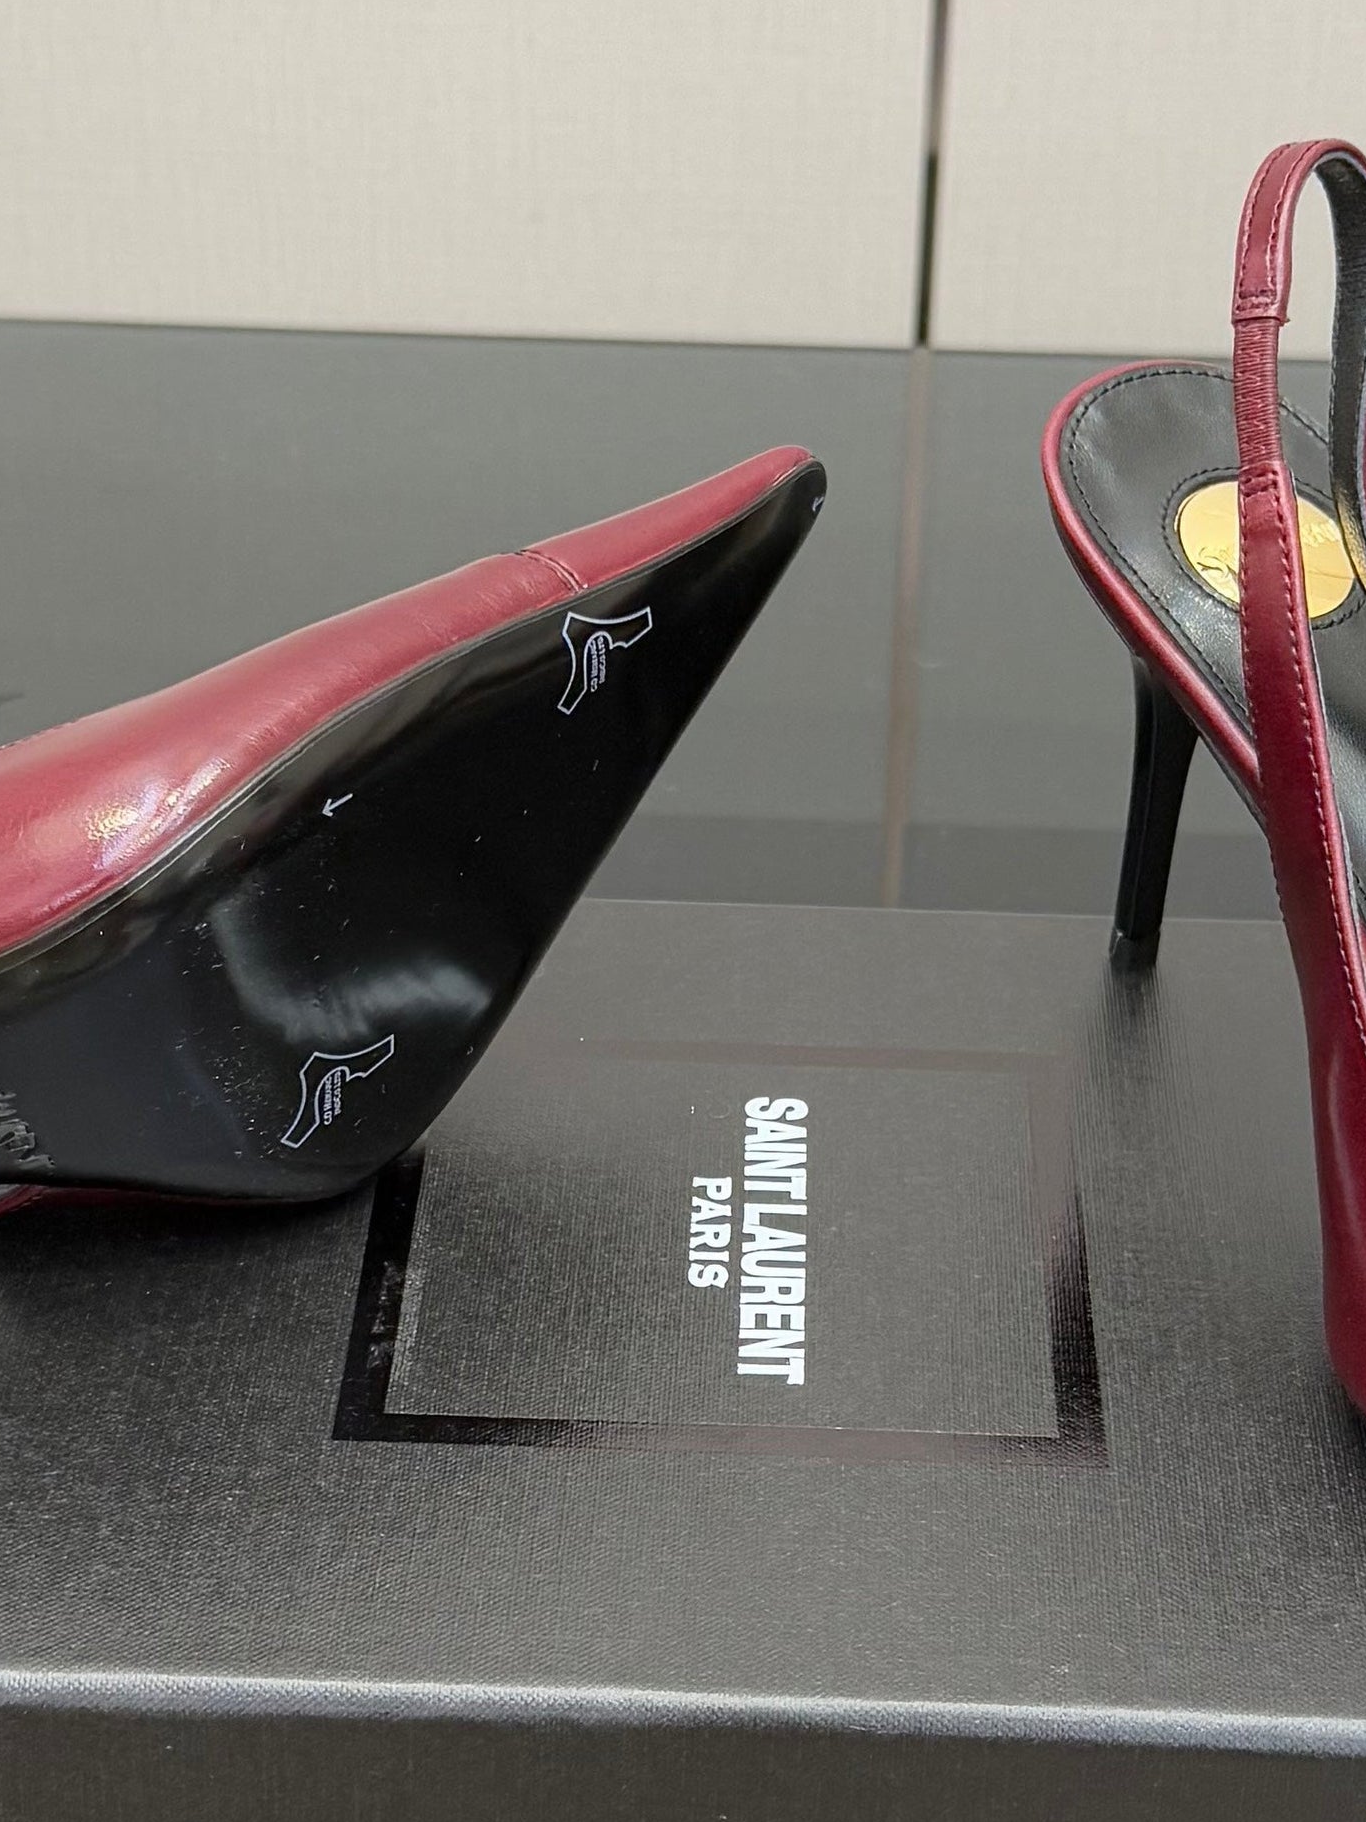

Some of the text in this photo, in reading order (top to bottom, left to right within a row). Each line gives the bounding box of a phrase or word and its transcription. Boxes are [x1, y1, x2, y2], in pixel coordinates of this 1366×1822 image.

[687, 1176, 733, 1289] PARIS
[737, 1096, 809, 1385] SAINT LAURENT
